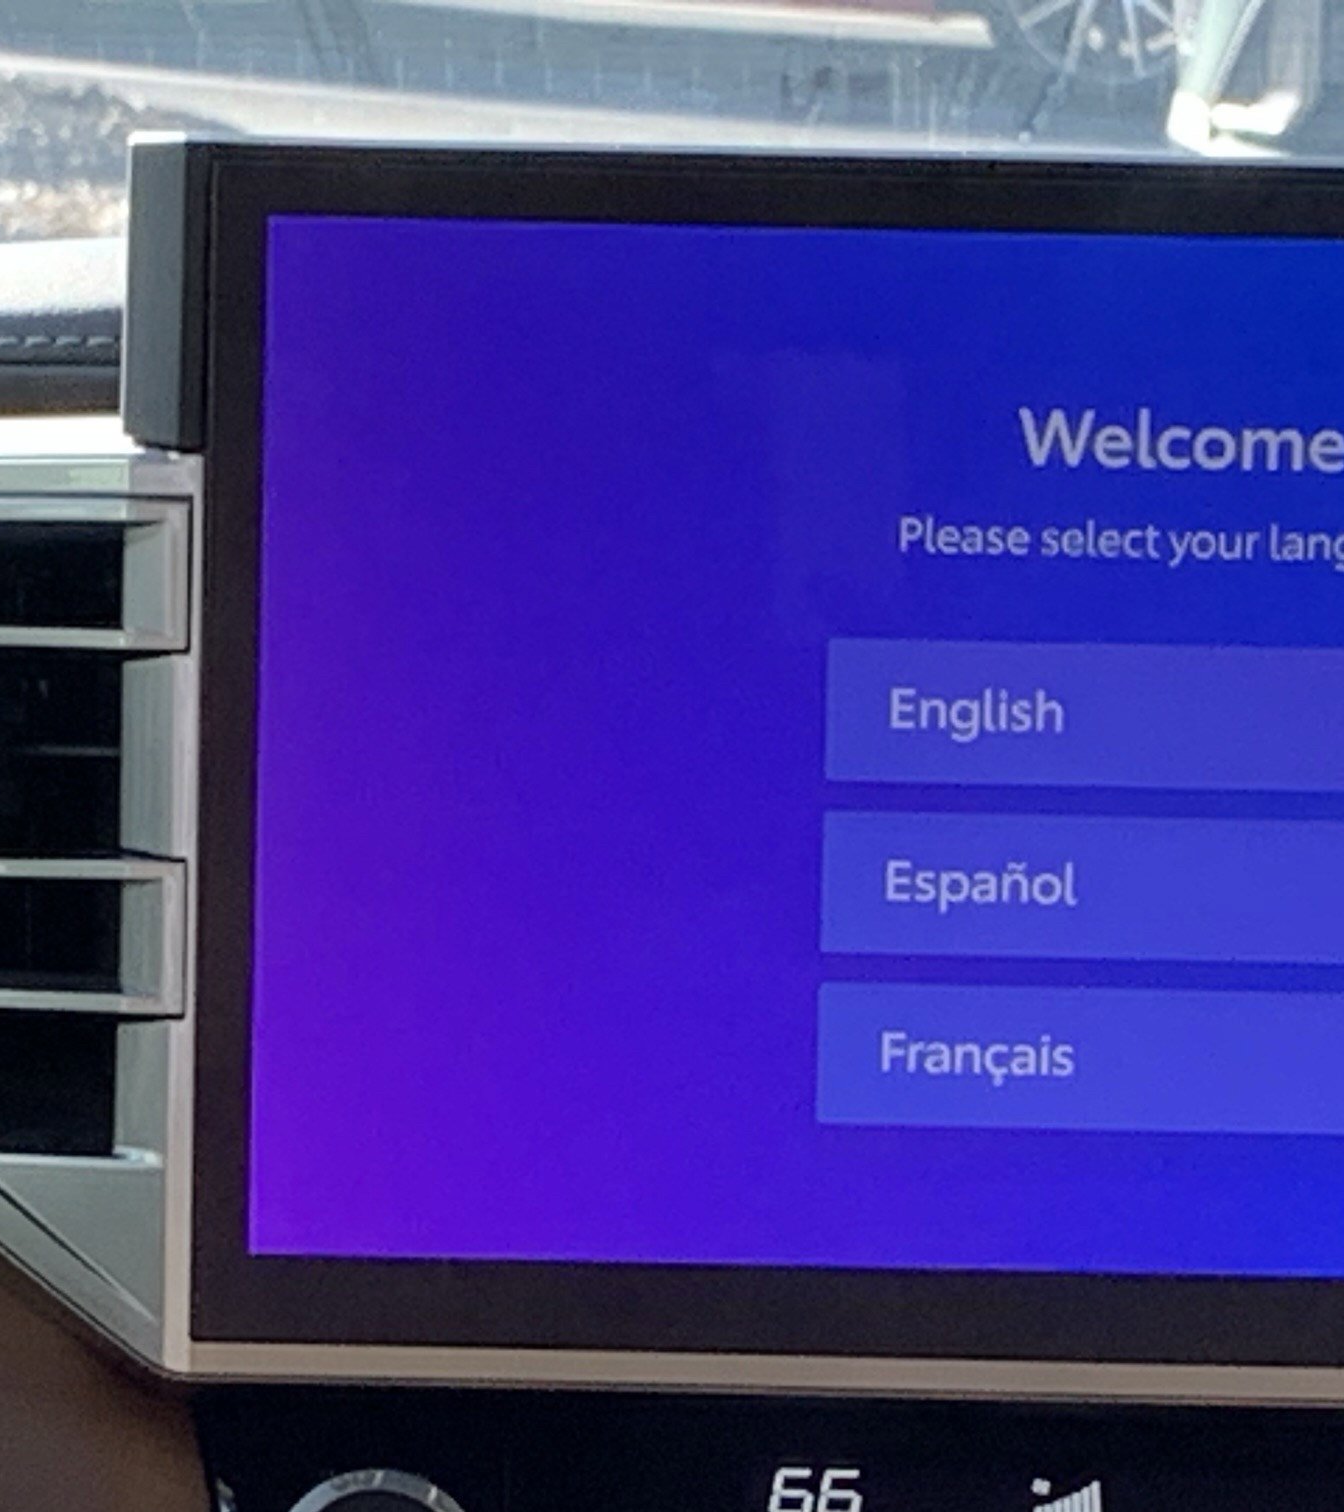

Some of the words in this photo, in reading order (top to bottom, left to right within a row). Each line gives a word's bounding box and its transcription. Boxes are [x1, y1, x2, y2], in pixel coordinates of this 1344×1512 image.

[898, 516, 1031, 558] Please
[1040, 519, 1160, 561] select
[1167, 527, 1259, 568] your
[888, 687, 1065, 743] English
[884, 859, 1078, 914] Español
[878, 1030, 1076, 1088] Français
